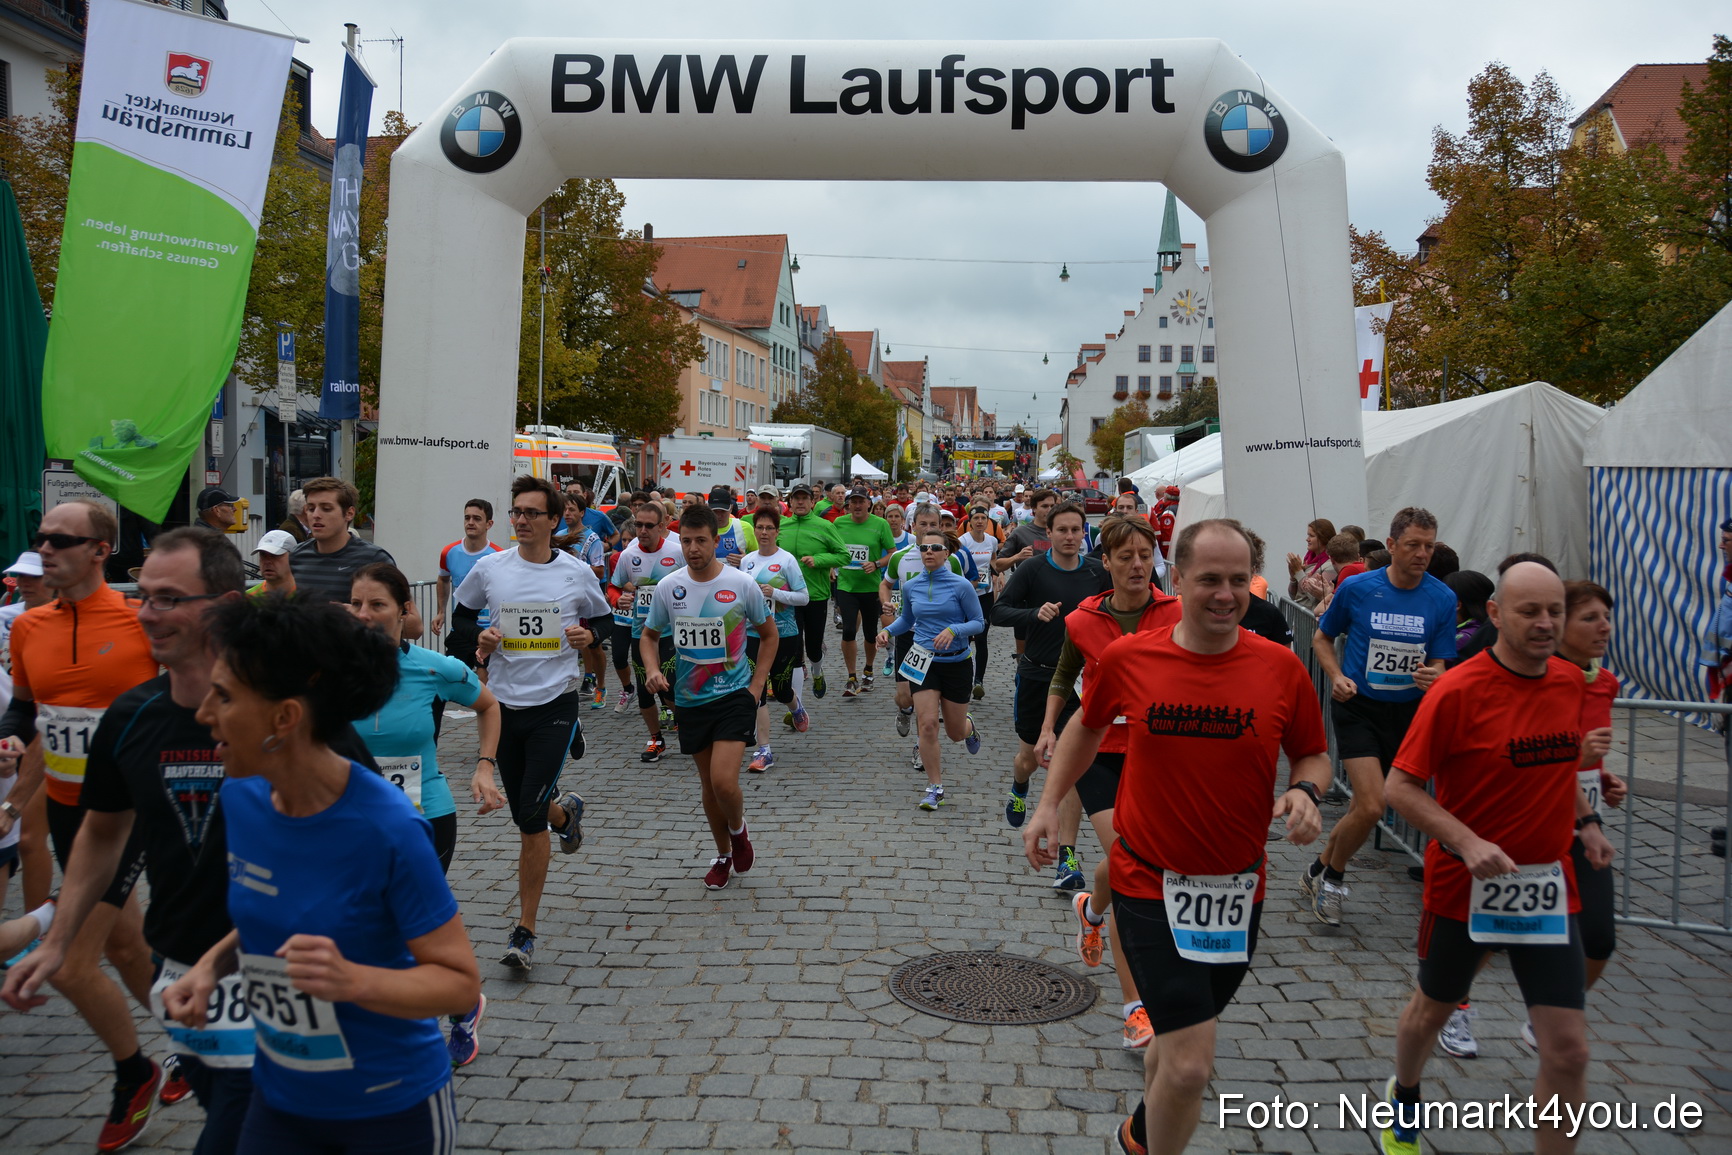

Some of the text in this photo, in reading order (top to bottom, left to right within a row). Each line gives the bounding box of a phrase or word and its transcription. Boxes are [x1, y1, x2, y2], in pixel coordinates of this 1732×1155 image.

[550, 53, 1176, 130] BMW Laufsport
[451, 91, 517, 119] BMW
[1212, 90, 1279, 119] BMW
[330, 380, 360, 393] railon
[240, 433, 247, 447] 3
[380, 435, 490, 450] www.bmw-laufsport.de
[1245, 437, 1361, 453] www.bmw-laufsport.de
[47, 480, 85, 489] Fußgänger
[519, 615, 543, 636] 53
[1370, 611, 1425, 628] HUBER
[1381, 624, 1423, 633] TECHNOLOGY
[503, 640, 559, 649] Emilio Antonio
[679, 628, 721, 647] 3118
[1371, 642, 1419, 654] PARTL Neumarkt
[1373, 651, 1421, 673] 2545
[713, 675, 726, 684] 16.
[1152, 719, 1238, 735] RUN FOR BÜRNI
[164, 765, 225, 778] BRAVEHEART
[379, 763, 408, 771] umarkt
[1166, 877, 1242, 890] PARTL Neumarkt
[1481, 881, 1559, 912] 2239
[1174, 891, 1246, 927] 2015
[1493, 918, 1543, 932] Michael
[1191, 934, 1231, 950] Andreas
[184, 1033, 220, 1050] Frank
